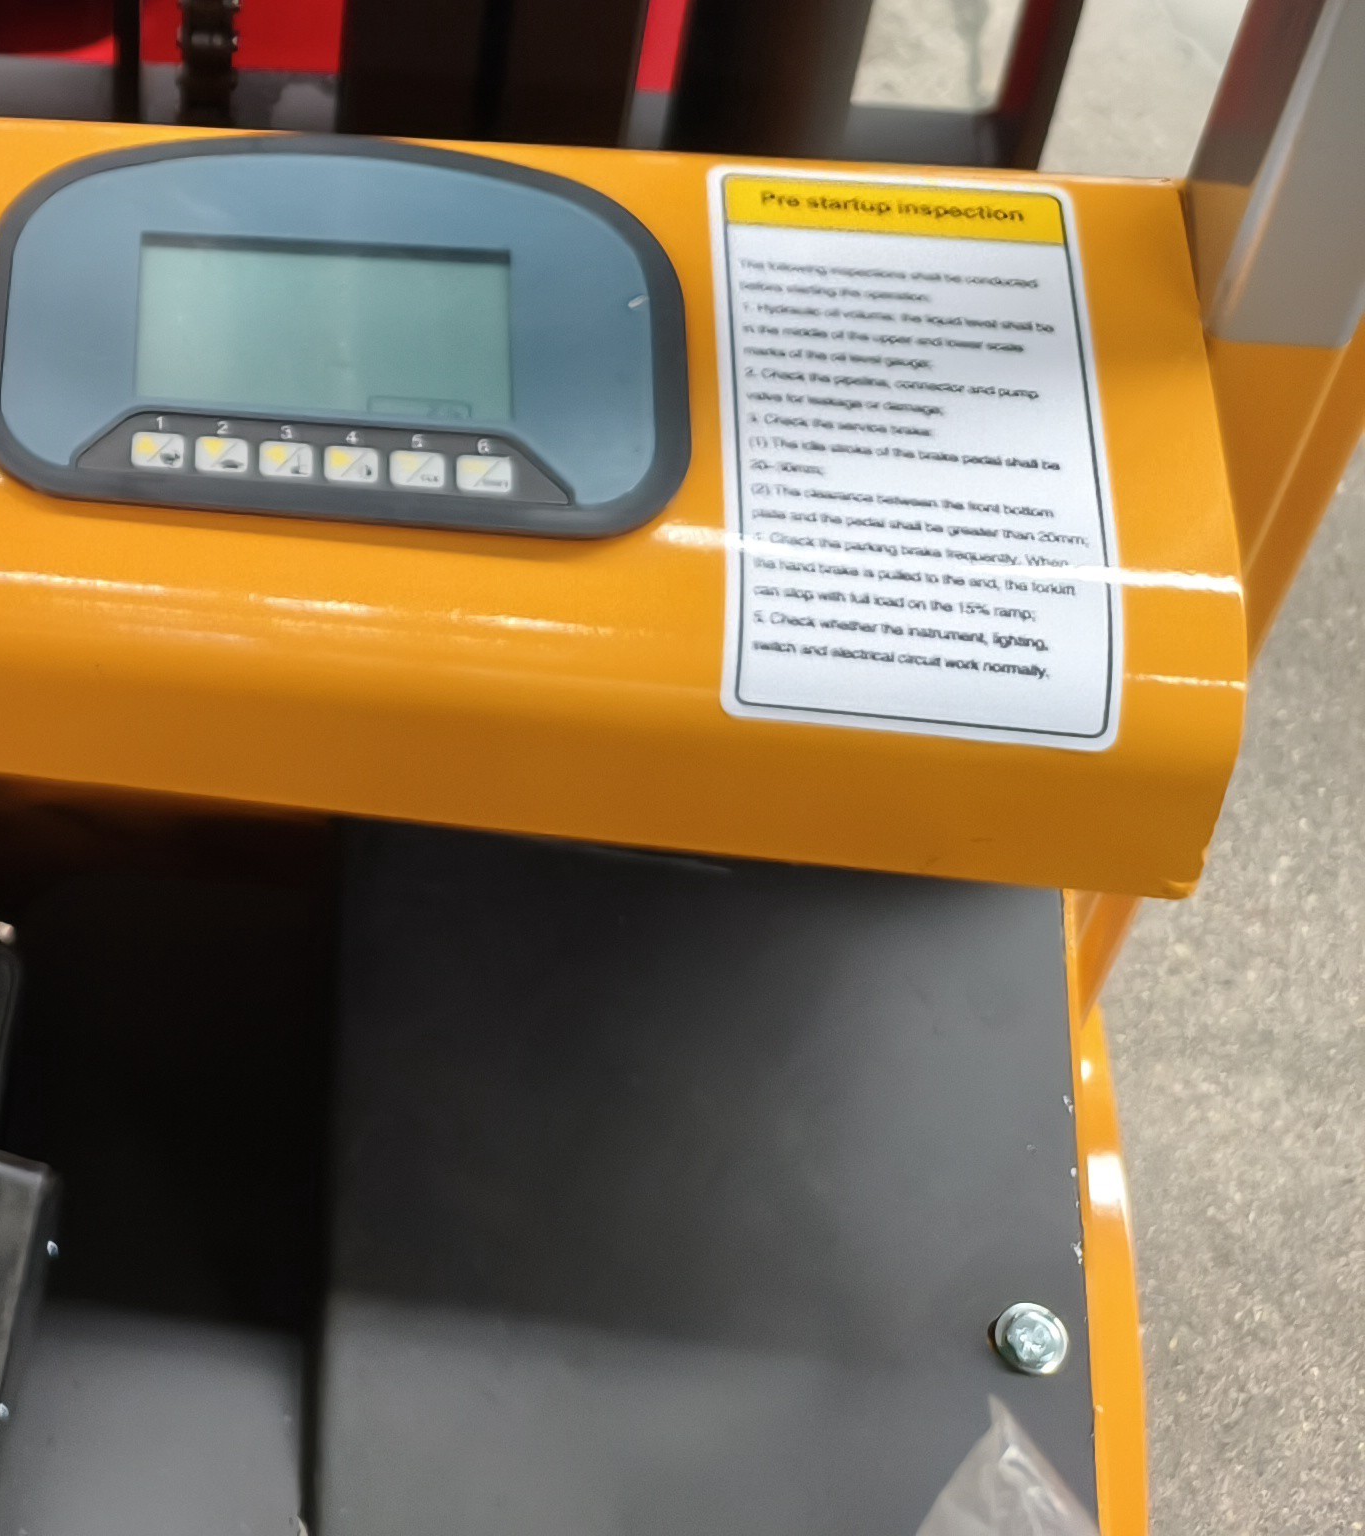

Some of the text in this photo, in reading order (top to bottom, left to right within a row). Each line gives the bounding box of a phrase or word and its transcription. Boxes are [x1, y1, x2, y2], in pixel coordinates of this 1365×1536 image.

[760, 190, 1025, 223] Pre startup inspection
[966, 276, 1038, 288] conducted
[757, 326, 779, 335] the
[847, 332, 869, 342] the
[1001, 322, 1033, 332] shall
[805, 351, 827, 361] the
[760, 369, 805, 380] Check
[809, 373, 831, 383] the
[894, 380, 964, 392] connector
[968, 385, 996, 395] and
[998, 387, 1039, 399] pump
[786, 394, 804, 403] for
[155, 415, 165, 431] 1
[216, 419, 230, 436] 2
[279, 424, 294, 440] 3
[345, 429, 360, 445] 4
[764, 415, 808, 427] Check
[812, 419, 834, 429] the
[772, 438, 798, 450] The
[892, 449, 915, 459] the
[918, 451, 959, 463] brake
[962, 456, 1002, 466] pedal
[1005, 458, 1038, 469] shall
[751, 483, 770, 495] (2)
[774, 485, 801, 496] The
[876, 495, 937, 507] between
[942, 500, 964, 510] the
[967, 502, 1000, 513] front
[1003, 506, 1055, 518] bottom
[790, 513, 817, 522] and
[820, 514, 842, 524] the
[846, 517, 885, 528] pedal
[889, 521, 922, 531] shall
[947, 526, 999, 537] greater
[1002, 530, 1035, 540] than
[769, 533, 815, 546] Check
[818, 538, 841, 549] the
[845, 540, 898, 556] parking
[901, 544, 942, 557] brake
[1025, 554, 1069, 566] When
[779, 560, 816, 573] hand
[819, 563, 859, 576] brake
[878, 569, 921, 581] pulled
[942, 574, 965, 585] the
[1005, 580, 1028, 590] the
[753, 587, 779, 596] can
[783, 589, 814, 601] stop
[818, 592, 846, 602] with
[849, 593, 870, 604] full
[874, 596, 904, 607] load
[930, 601, 953, 611] the
[770, 613, 815, 626] Check
[819, 620, 877, 632] whether
[880, 624, 904, 635] the
[752, 641, 1050, 678] switch and electrical circuit work normally.
